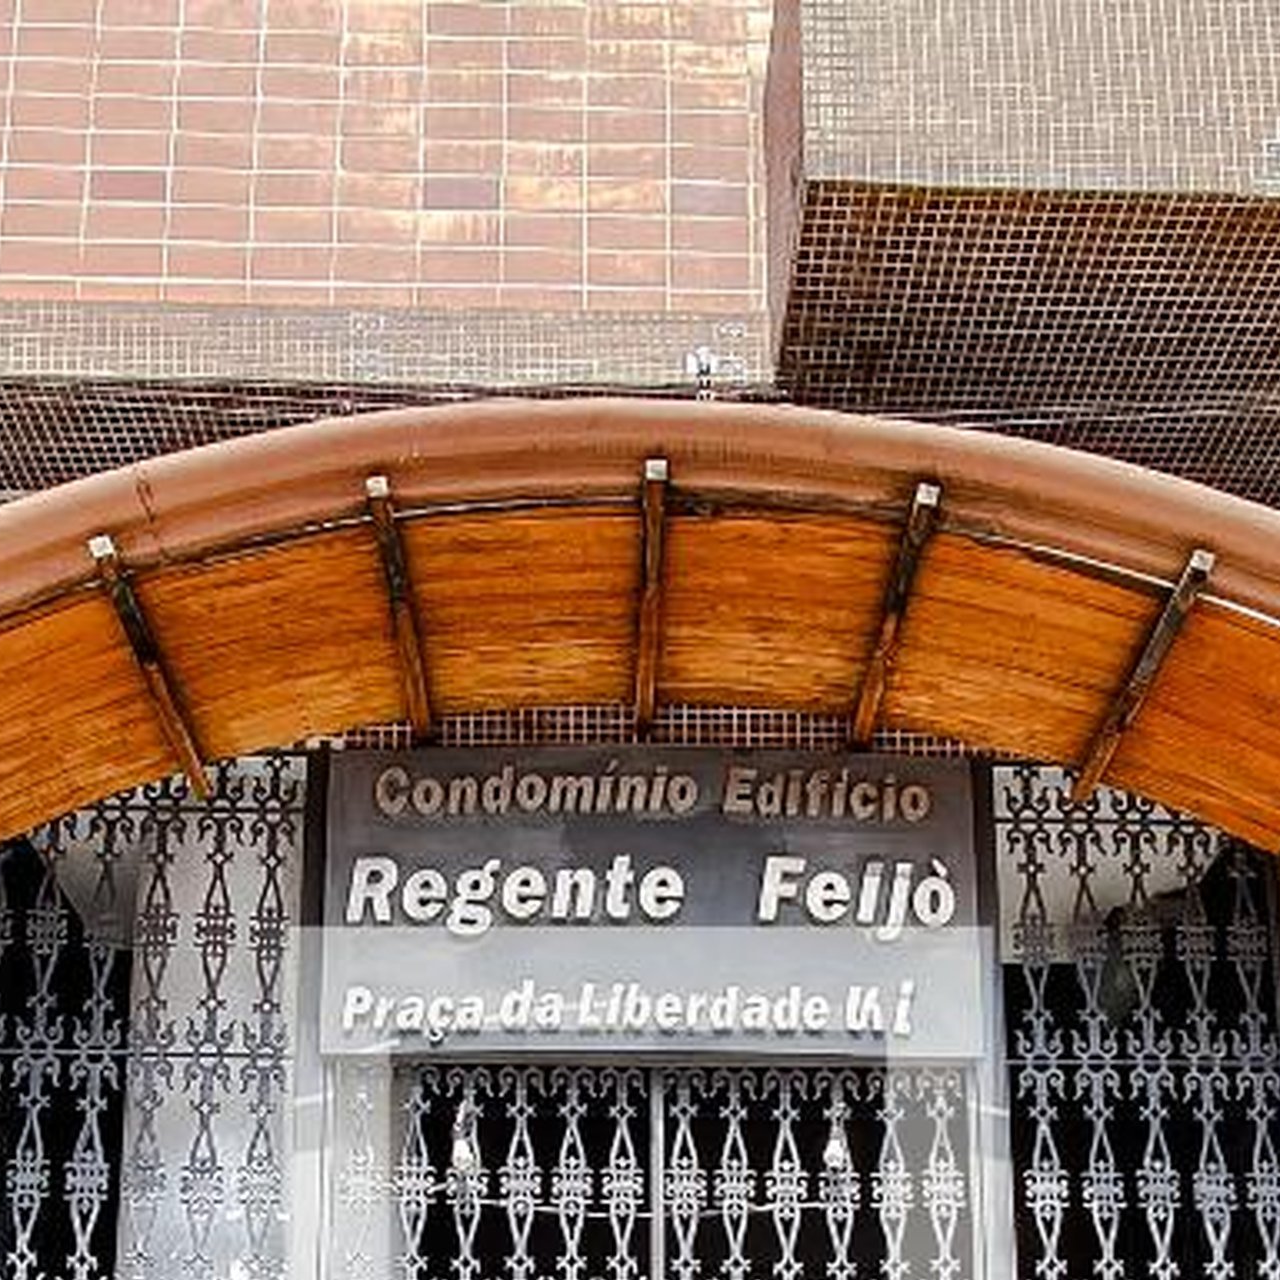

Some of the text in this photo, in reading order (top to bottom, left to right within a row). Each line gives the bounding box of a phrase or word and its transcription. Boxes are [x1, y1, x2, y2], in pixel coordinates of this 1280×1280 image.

[375, 760, 698, 816] Condomínio
[345, 855, 685, 934] Regente
[342, 985, 484, 1041] Praça
[499, 979, 562, 1028] da
[577, 983, 830, 1031] Liberdade
